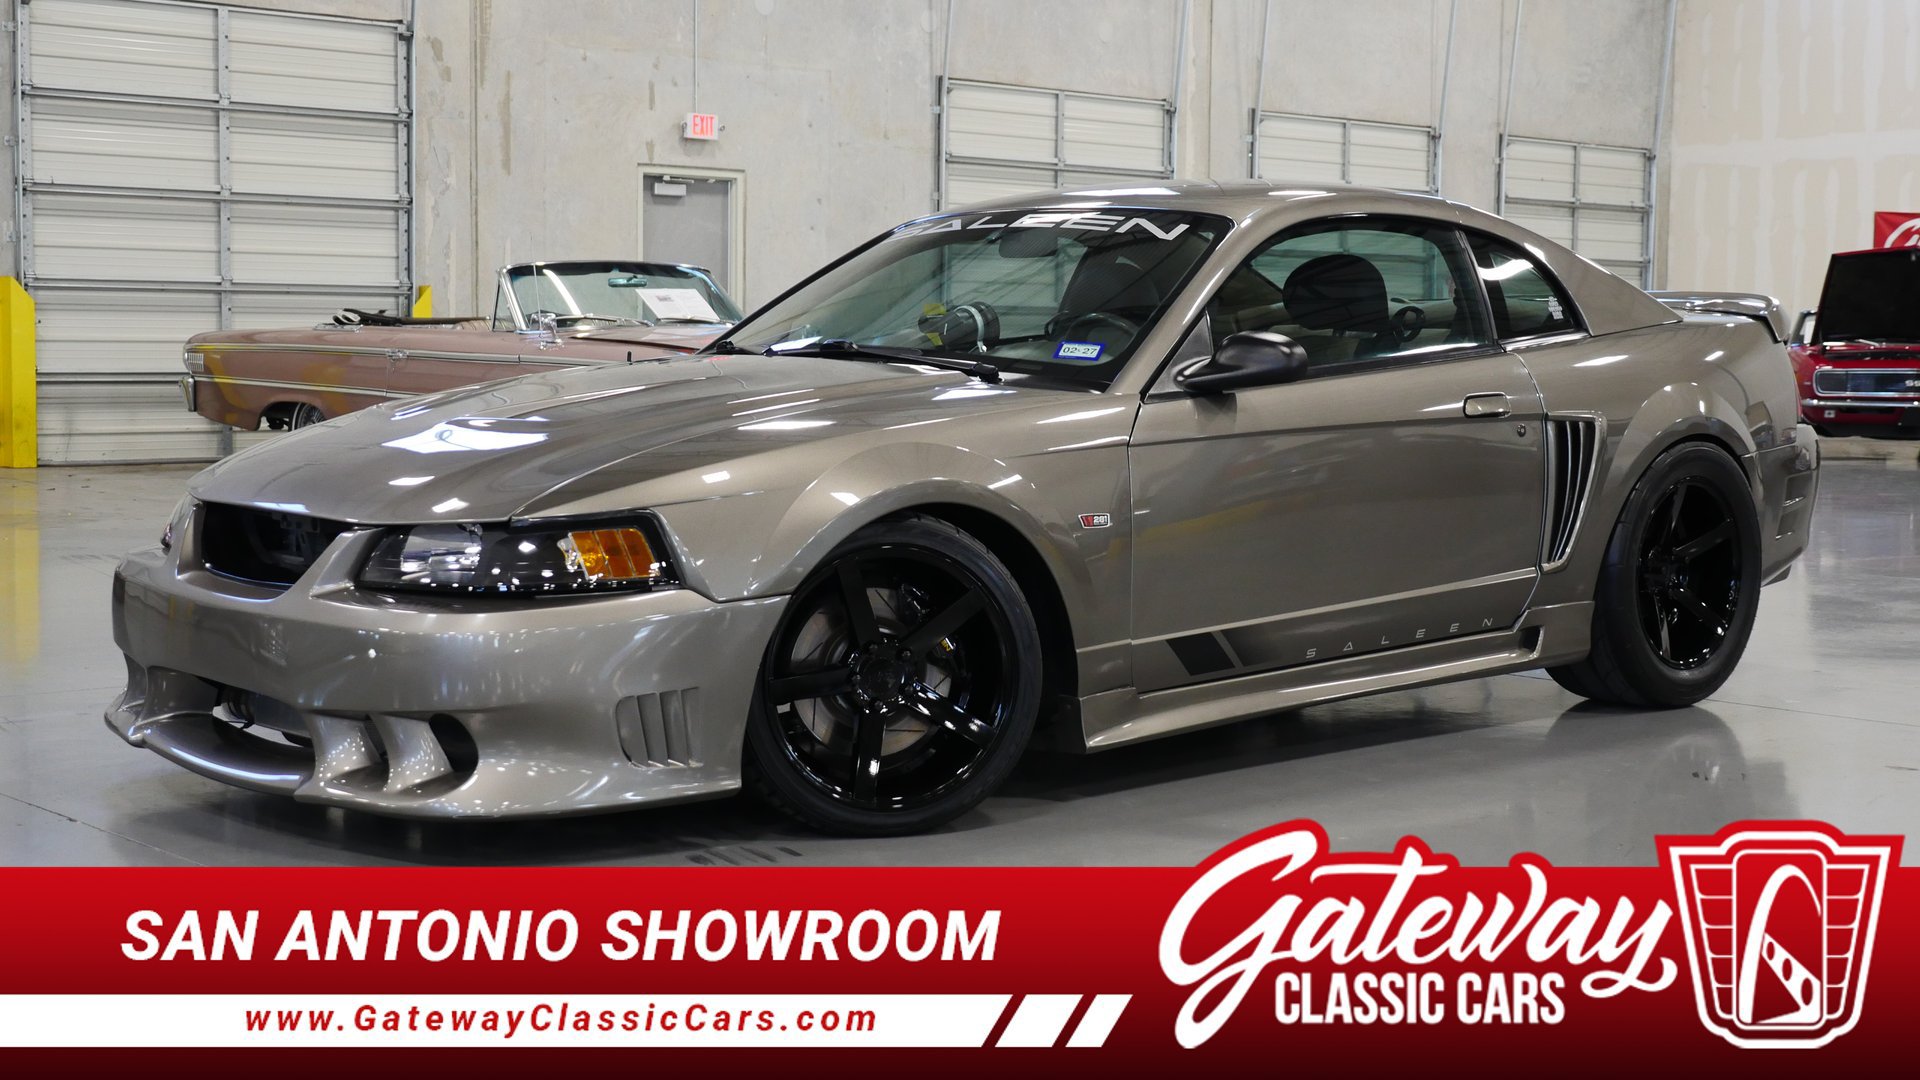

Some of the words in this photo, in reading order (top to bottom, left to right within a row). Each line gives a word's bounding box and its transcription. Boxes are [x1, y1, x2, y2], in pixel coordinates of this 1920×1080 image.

[692, 114, 715, 137] EXIT
[884, 212, 1190, 242] SALEEN
[1306, 617, 1493, 659] SALEEN
